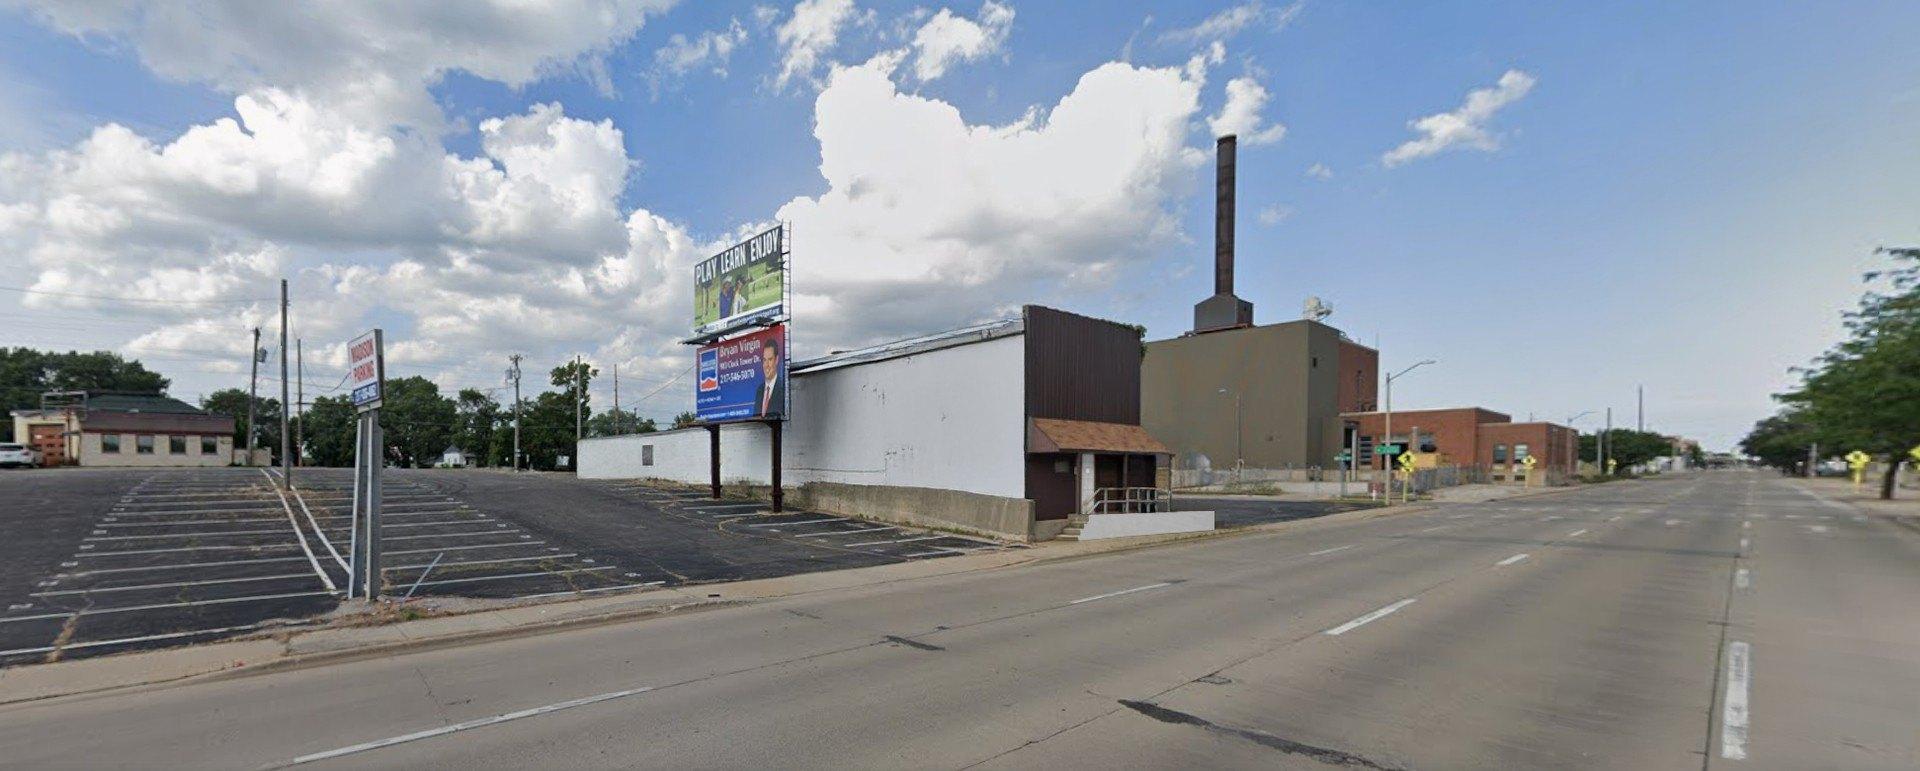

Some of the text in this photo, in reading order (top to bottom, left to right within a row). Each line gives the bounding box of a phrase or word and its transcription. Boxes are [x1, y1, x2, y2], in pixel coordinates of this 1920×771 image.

[695, 228, 779, 285] PLAY LEARN ENJOY
[720, 337, 760, 358] Bryan Virgin
